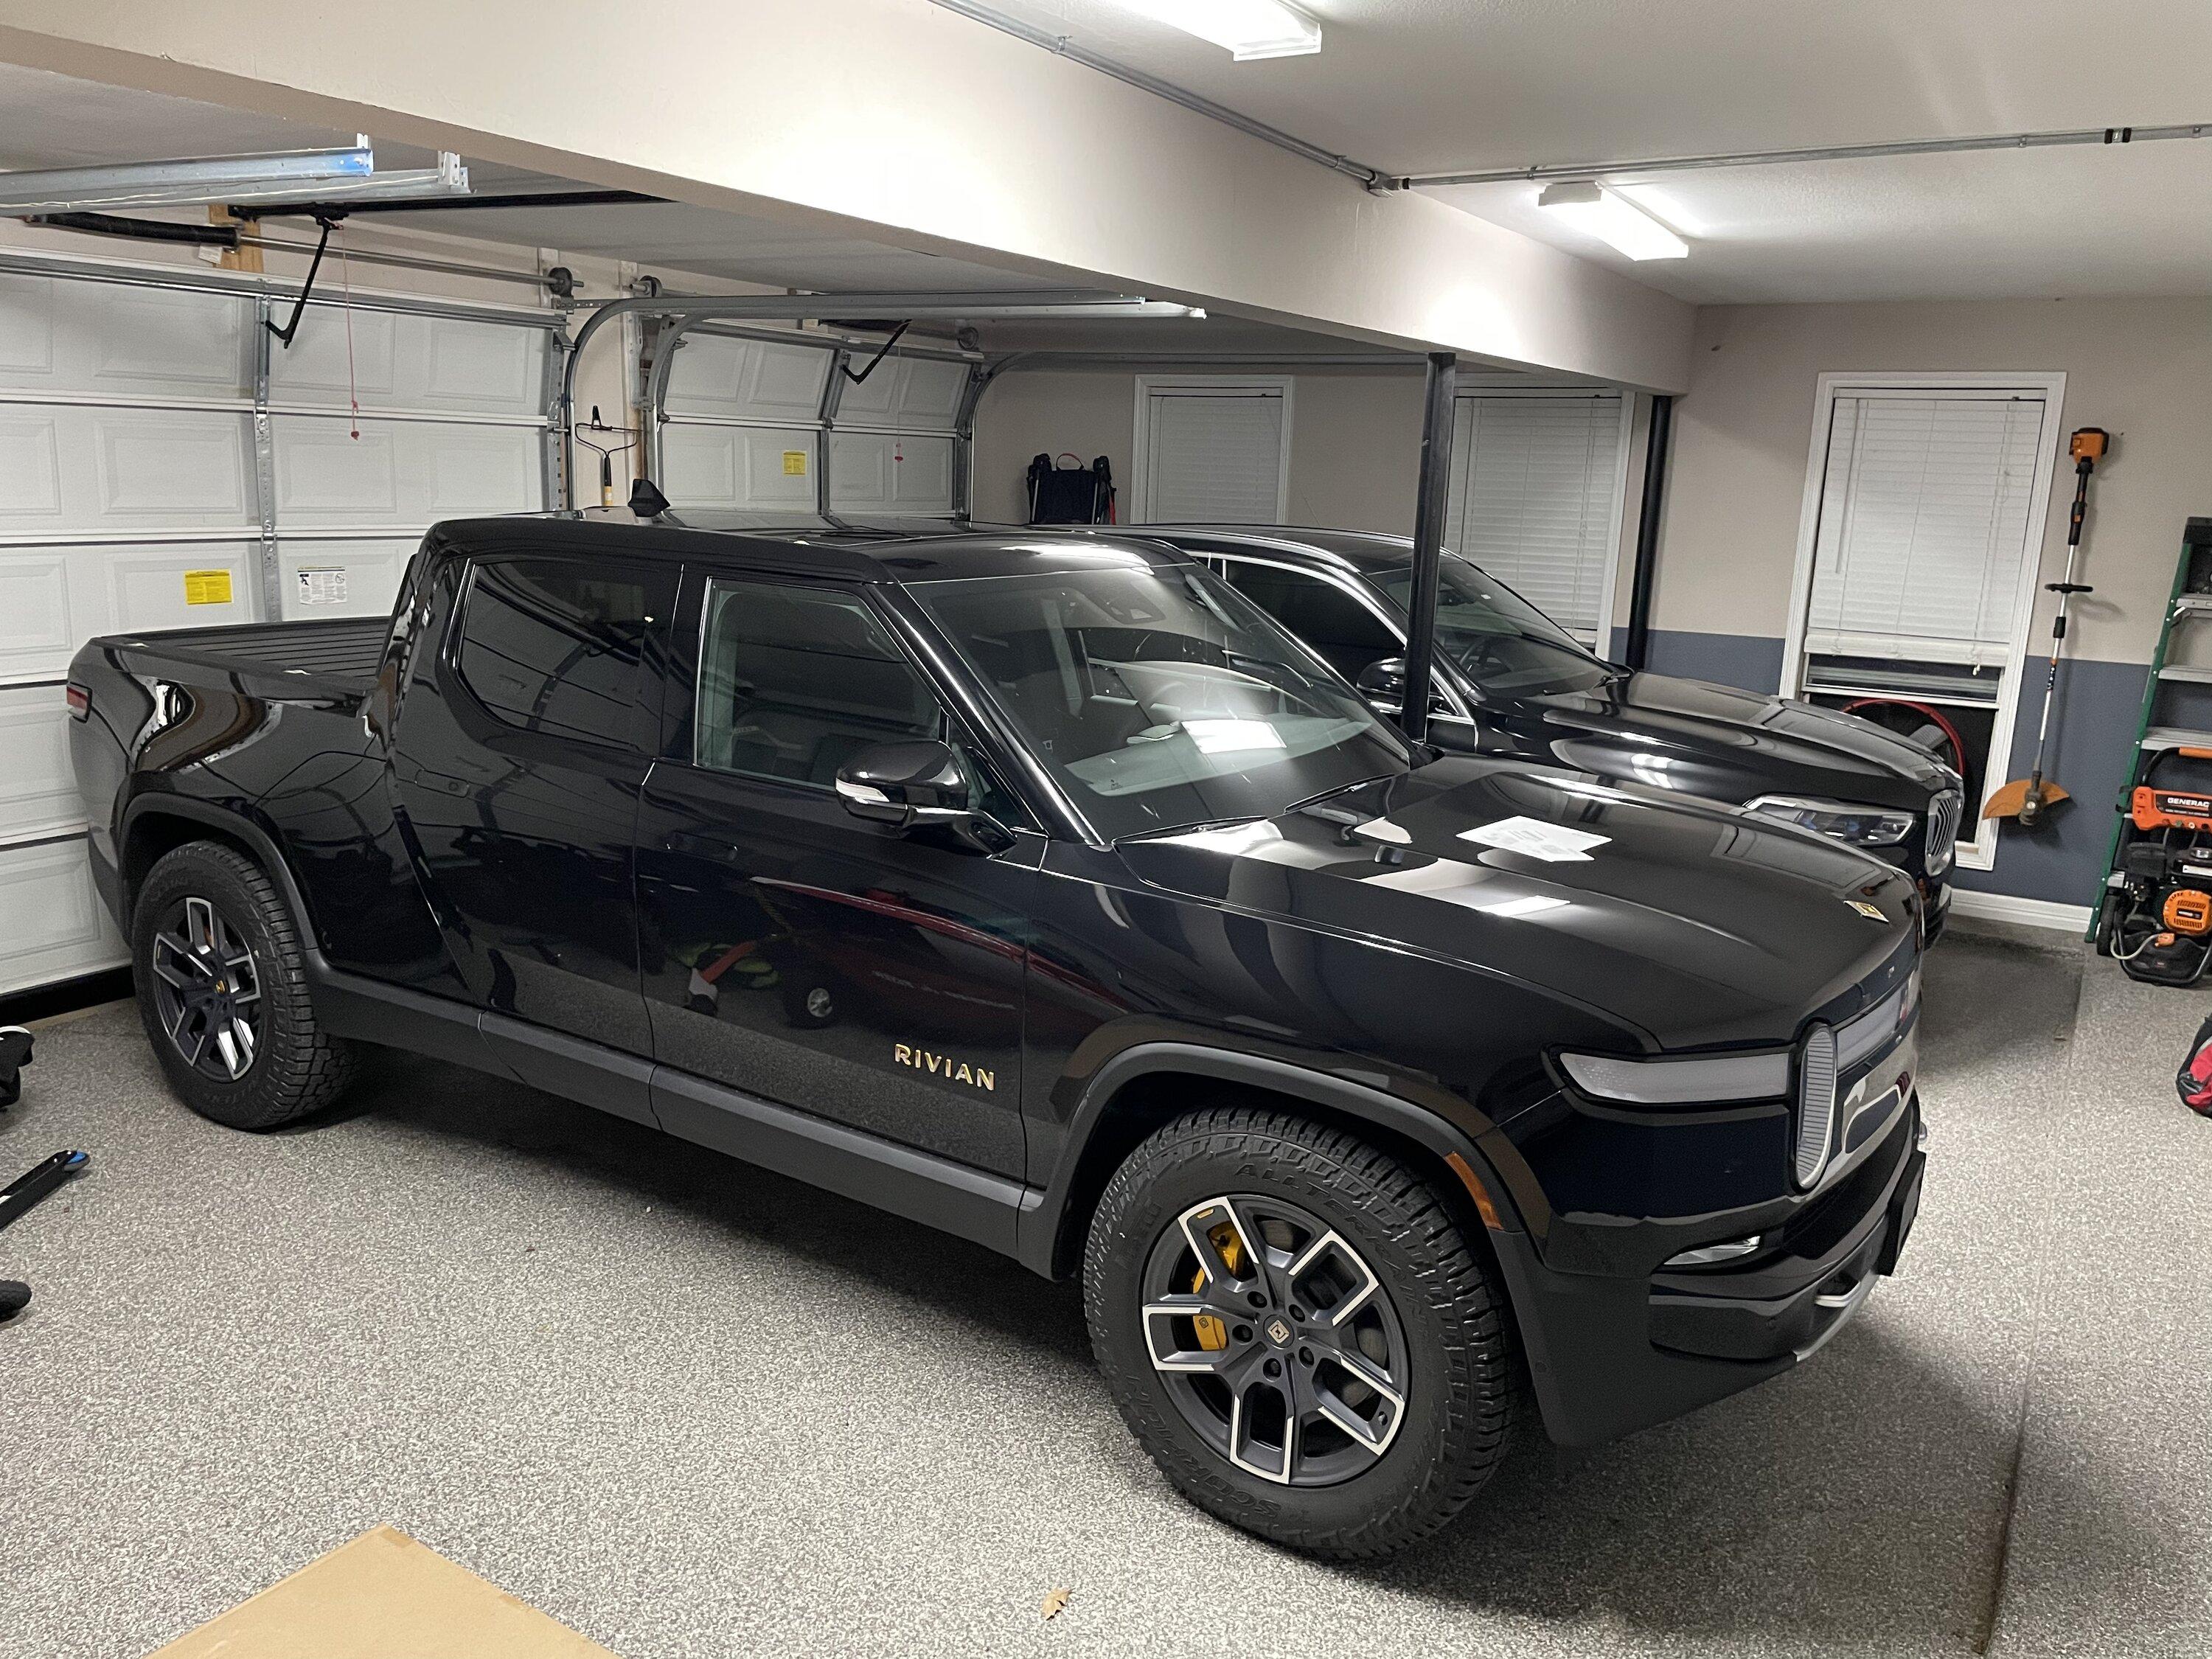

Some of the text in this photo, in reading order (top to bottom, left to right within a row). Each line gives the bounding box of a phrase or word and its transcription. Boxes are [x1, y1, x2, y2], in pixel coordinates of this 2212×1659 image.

[2168, 797, 2210, 807] GENERAC
[894, 1043, 995, 1091] RIVIAN
[1233, 1163, 1301, 1190] ALL
[1126, 1373, 1281, 1520] SCORPION
